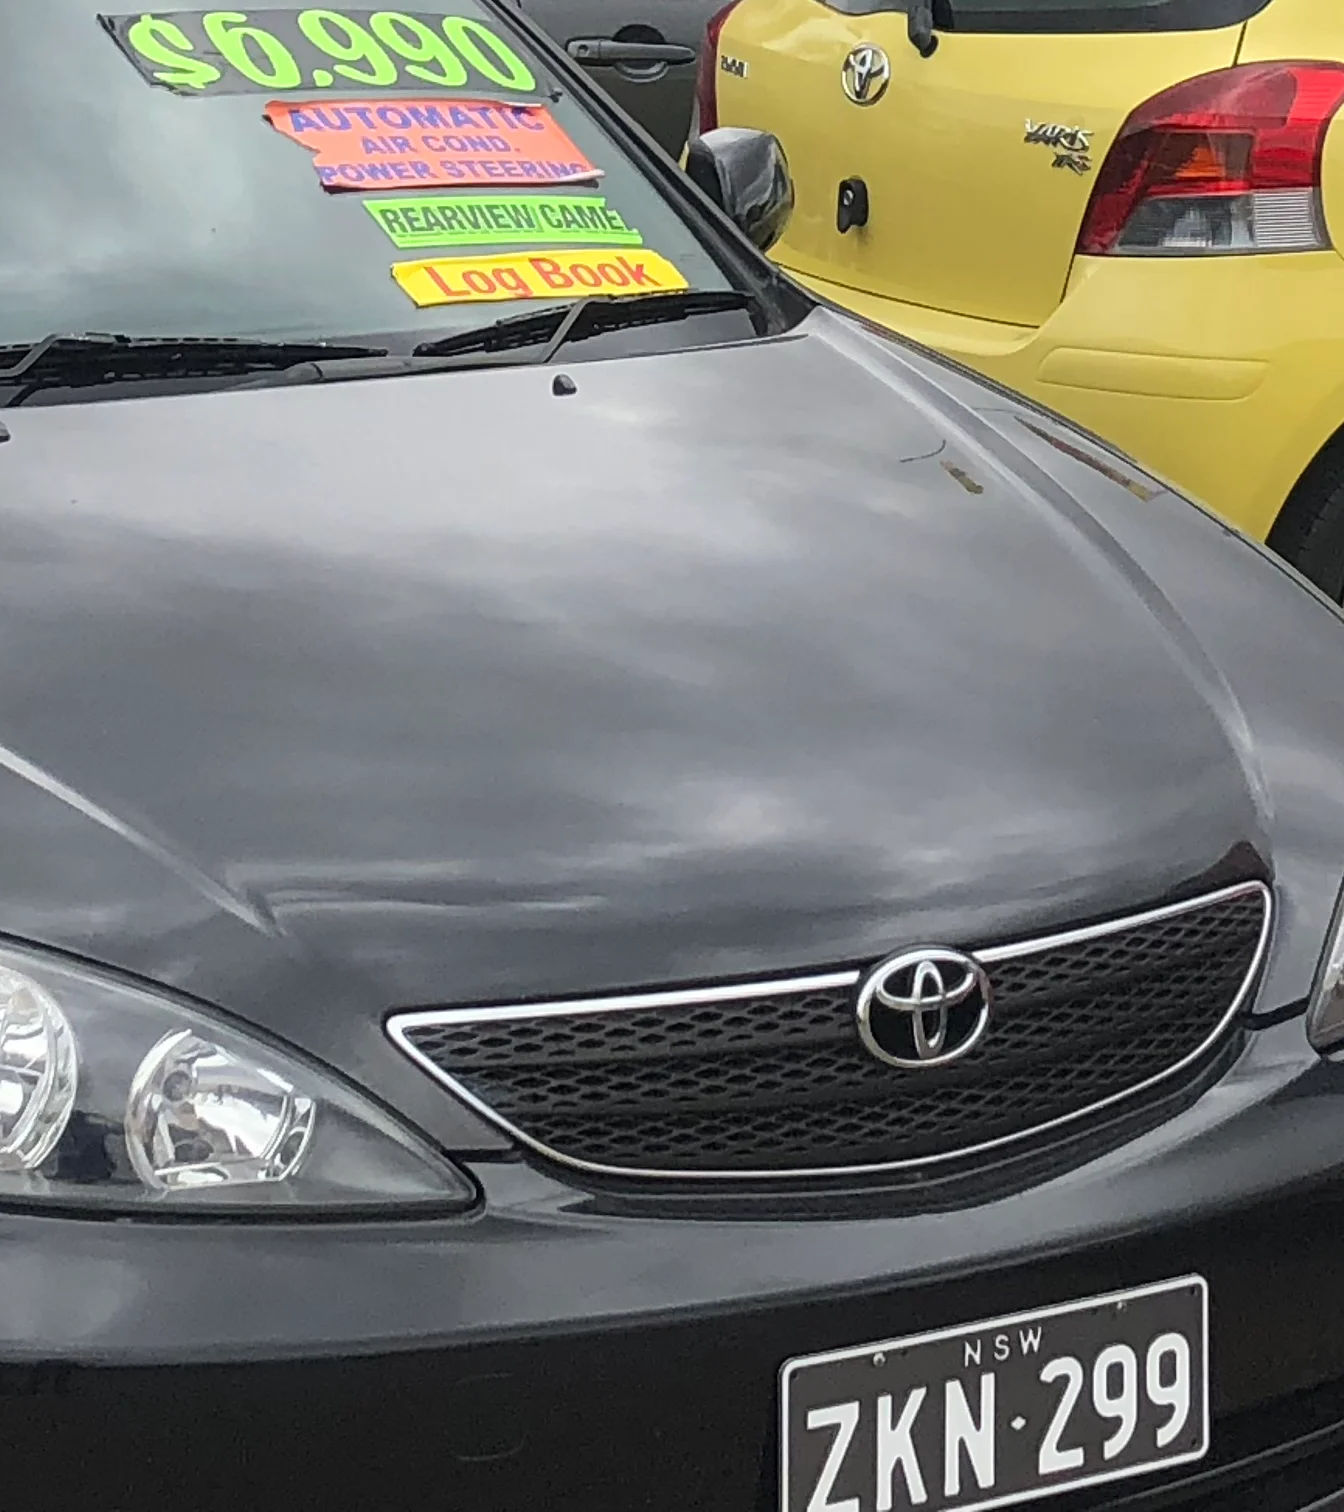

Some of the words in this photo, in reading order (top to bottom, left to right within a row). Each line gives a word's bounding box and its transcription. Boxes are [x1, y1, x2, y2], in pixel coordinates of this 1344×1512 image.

[127, 8, 537, 94] $6.990
[288, 105, 546, 133] AUTOMATIC
[360, 136, 419, 155] AIR
[421, 134, 522, 154] COND.
[316, 160, 438, 185] POWER
[440, 158, 589, 180] STEERING
[378, 202, 538, 234] REARVIEW
[422, 264, 535, 299] Log
[527, 255, 663, 291] Book
[963, 1326, 1044, 1368] NSW
